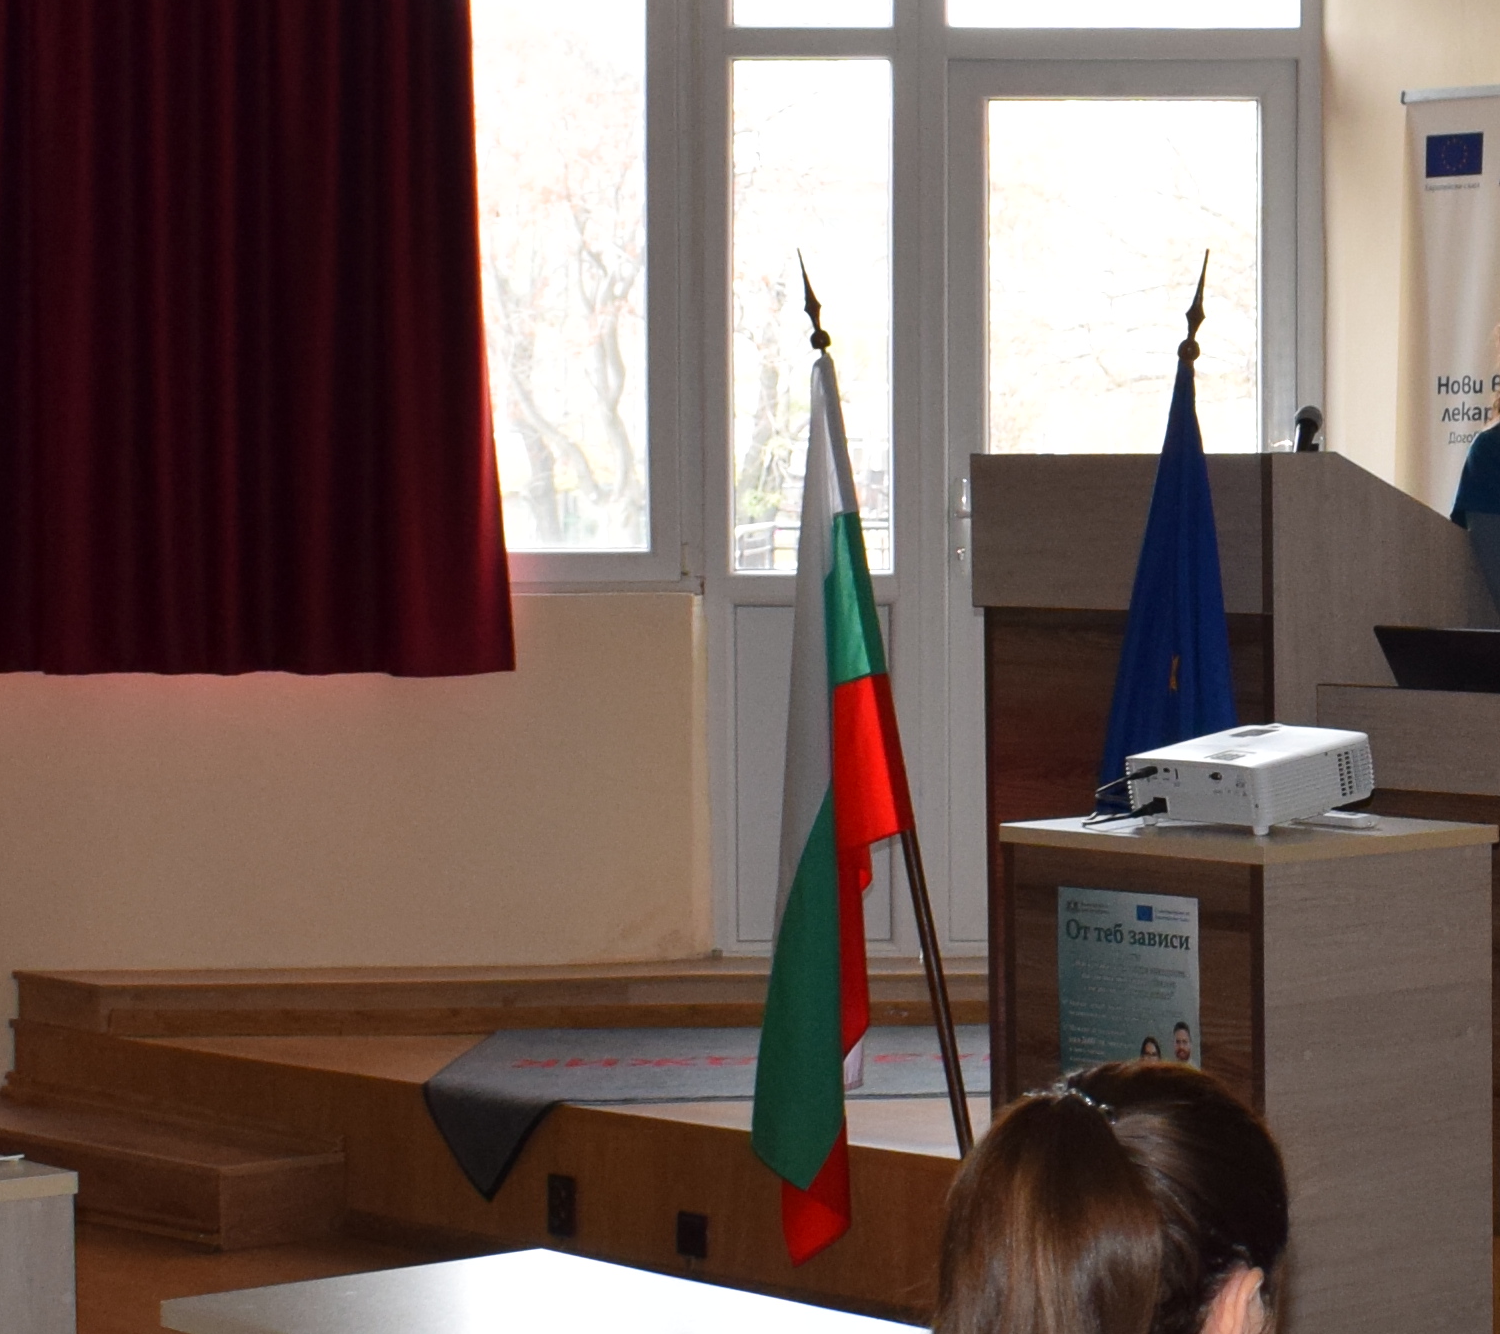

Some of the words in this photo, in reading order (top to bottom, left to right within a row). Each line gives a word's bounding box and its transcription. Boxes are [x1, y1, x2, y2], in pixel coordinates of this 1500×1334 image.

[1437, 375, 1484, 395] Нови
[1066, 919, 1091, 941] От
[1094, 923, 1124, 944] теб
[1128, 930, 1191, 950] зависи
